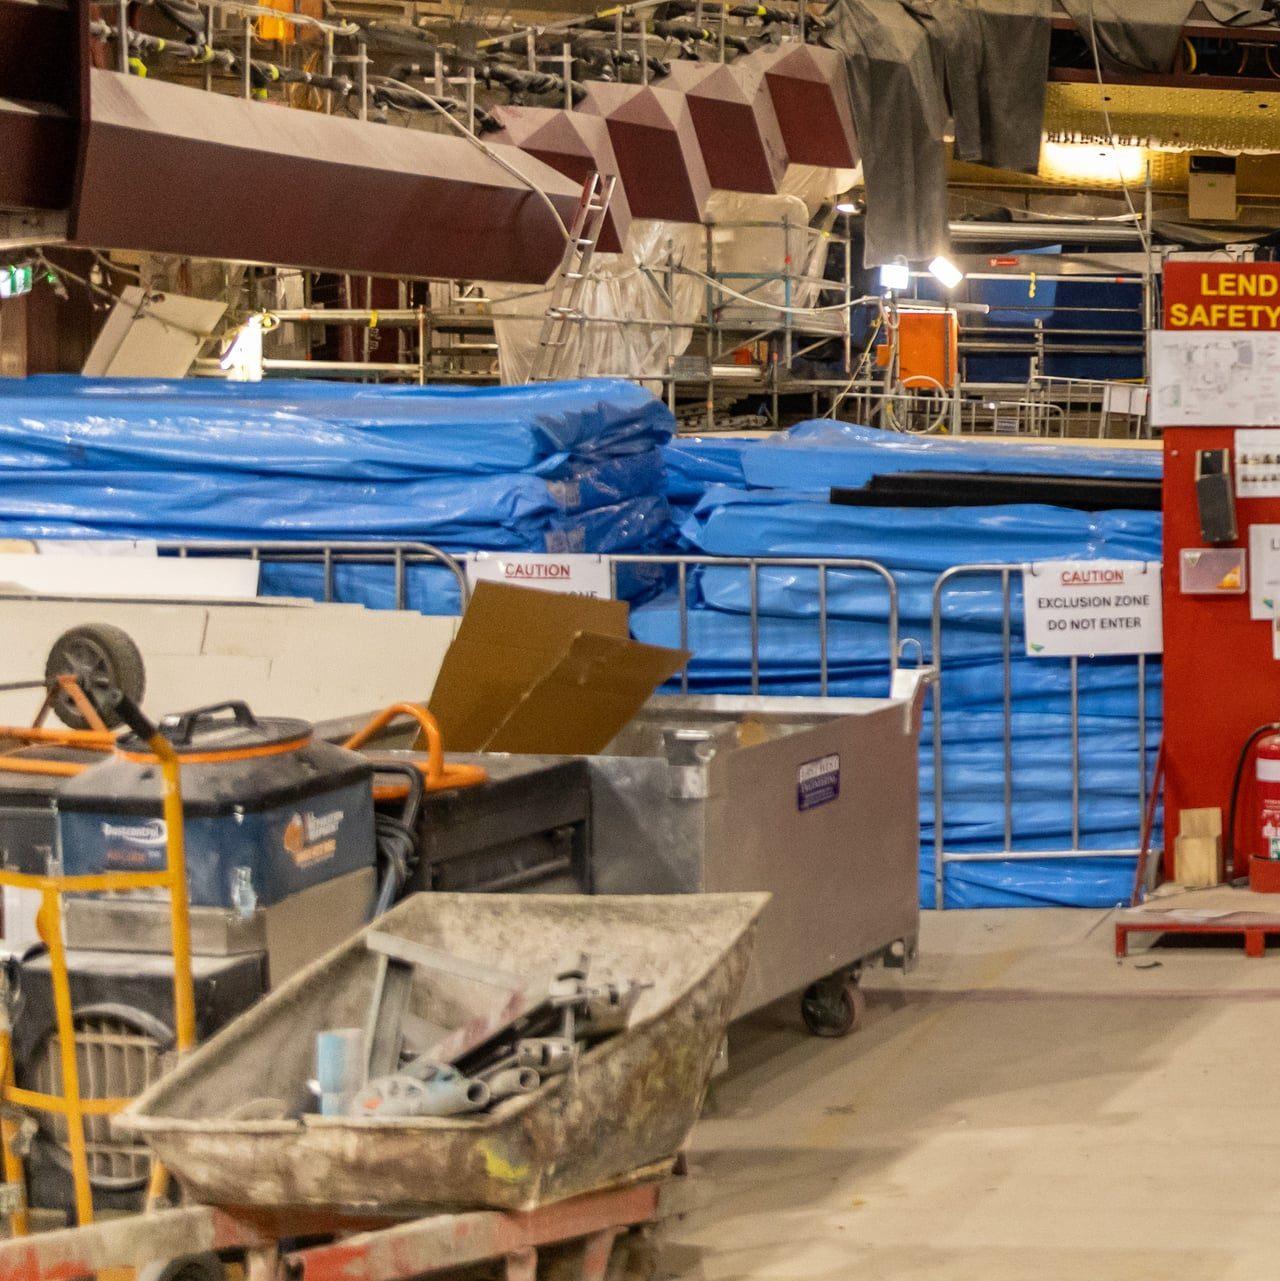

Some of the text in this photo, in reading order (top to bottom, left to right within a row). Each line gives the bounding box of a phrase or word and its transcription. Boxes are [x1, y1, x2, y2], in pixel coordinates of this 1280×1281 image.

[1200, 273, 1278, 296] LEND
[505, 563, 571, 577] CAUTION
[1061, 569, 1124, 583] CAUTION
[1038, 594, 1150, 609] EXCLUSION ZONE
[1048, 616, 1142, 631] DO NOT ENTER
